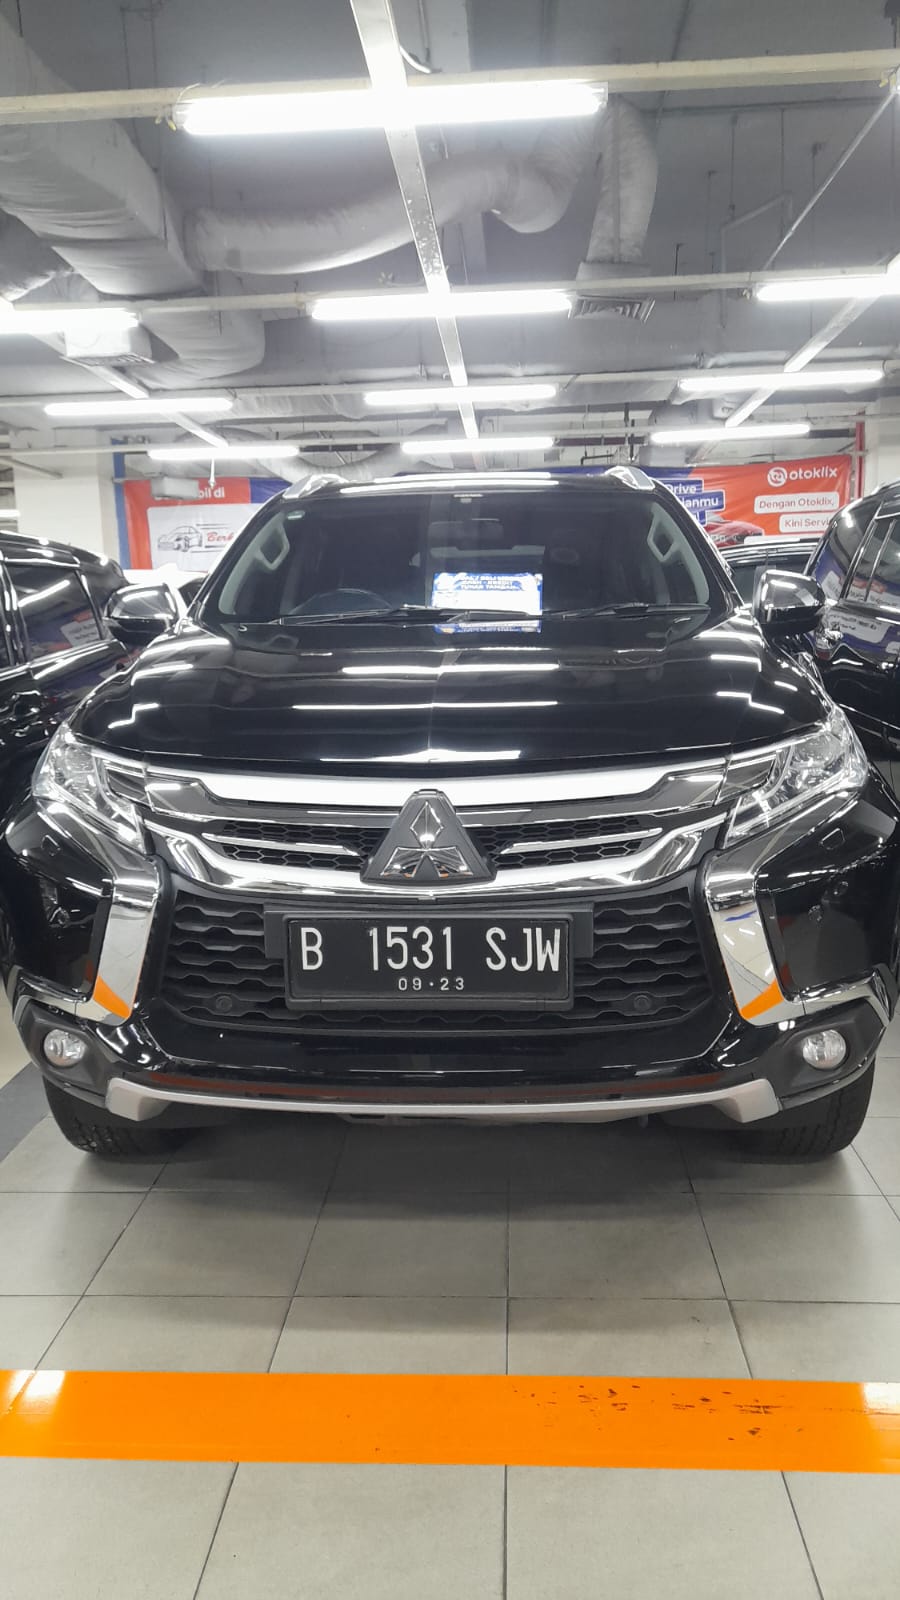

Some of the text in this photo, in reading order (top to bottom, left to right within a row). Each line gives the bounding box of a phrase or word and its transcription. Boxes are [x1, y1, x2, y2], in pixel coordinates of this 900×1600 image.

[789, 466, 838, 480] otoklix
[213, 487, 225, 498] di
[759, 500, 796, 510] Dengan
[784, 518, 829, 528] Kini Servi
[301, 926, 561, 972] B 1531 SJW
